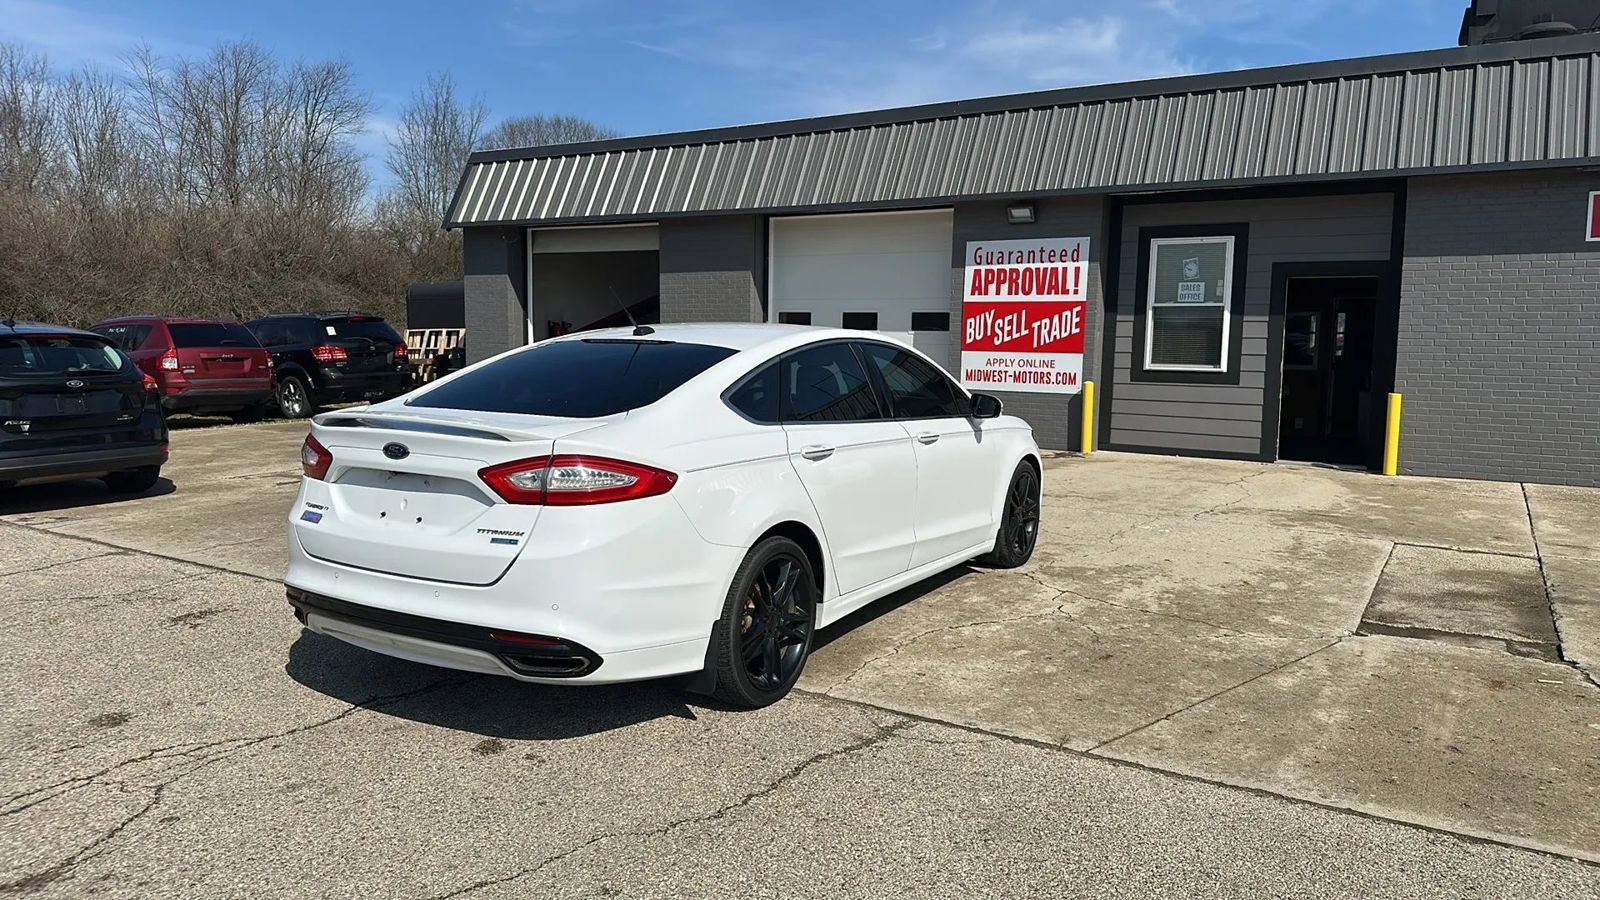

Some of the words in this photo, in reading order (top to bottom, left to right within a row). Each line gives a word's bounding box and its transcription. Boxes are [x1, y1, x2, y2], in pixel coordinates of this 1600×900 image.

[974, 243, 1081, 265] Guaranteed
[970, 266, 1081, 296] APPROVAL!
[1180, 284, 1201, 292] SALES
[1179, 293, 1201, 301] OFFICE
[965, 309, 995, 344] BUY
[993, 309, 1029, 346] SELL
[1031, 305, 1082, 348] TRADE
[985, 358, 1016, 369] APPLY
[1017, 358, 1056, 369] ONLINE
[965, 368, 1077, 386] MIDWEST-MOTORS.COM
[476, 528, 525, 537] TITANIUM
